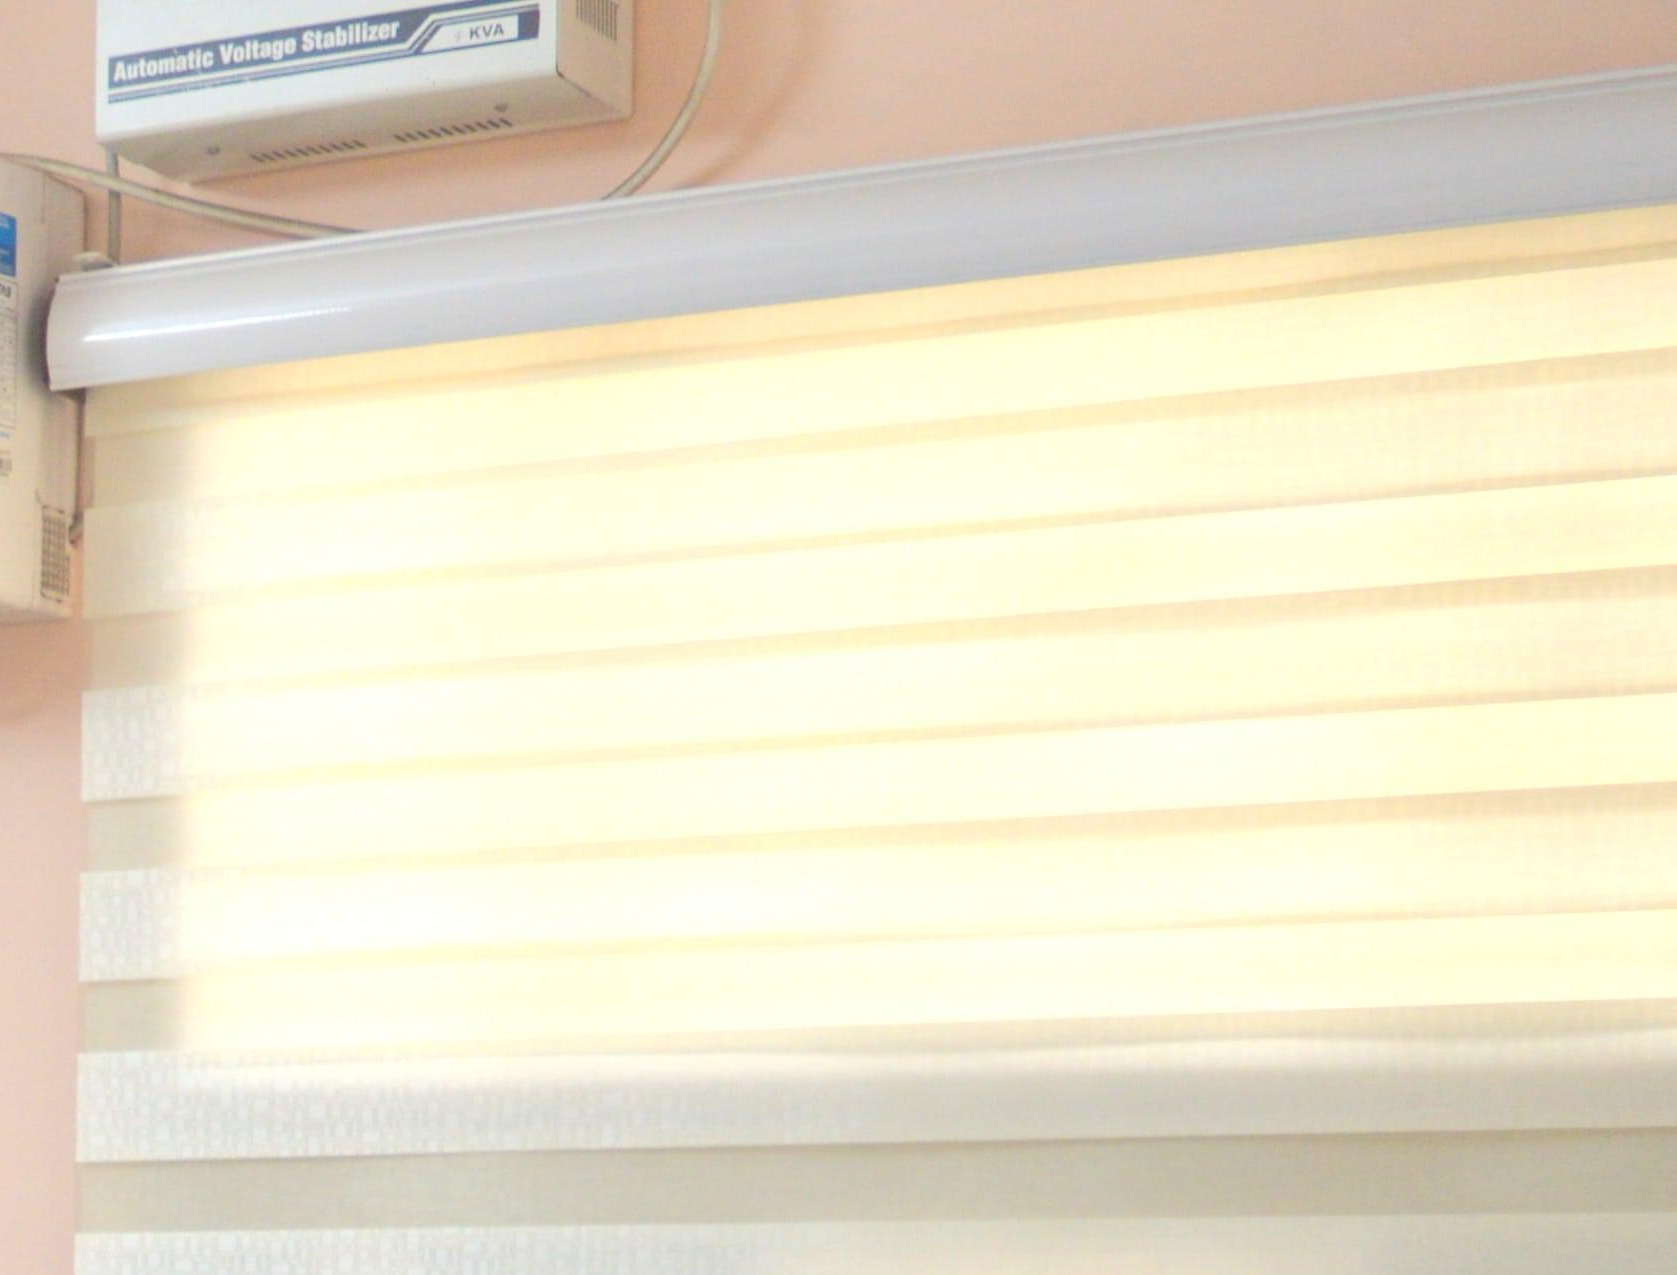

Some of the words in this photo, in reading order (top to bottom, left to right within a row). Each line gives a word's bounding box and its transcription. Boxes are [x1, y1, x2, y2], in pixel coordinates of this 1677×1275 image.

[468, 23, 505, 40] KVA
[113, 49, 214, 82] Automatic
[219, 36, 296, 65] Voltage
[301, 21, 400, 51] Stabilizer
